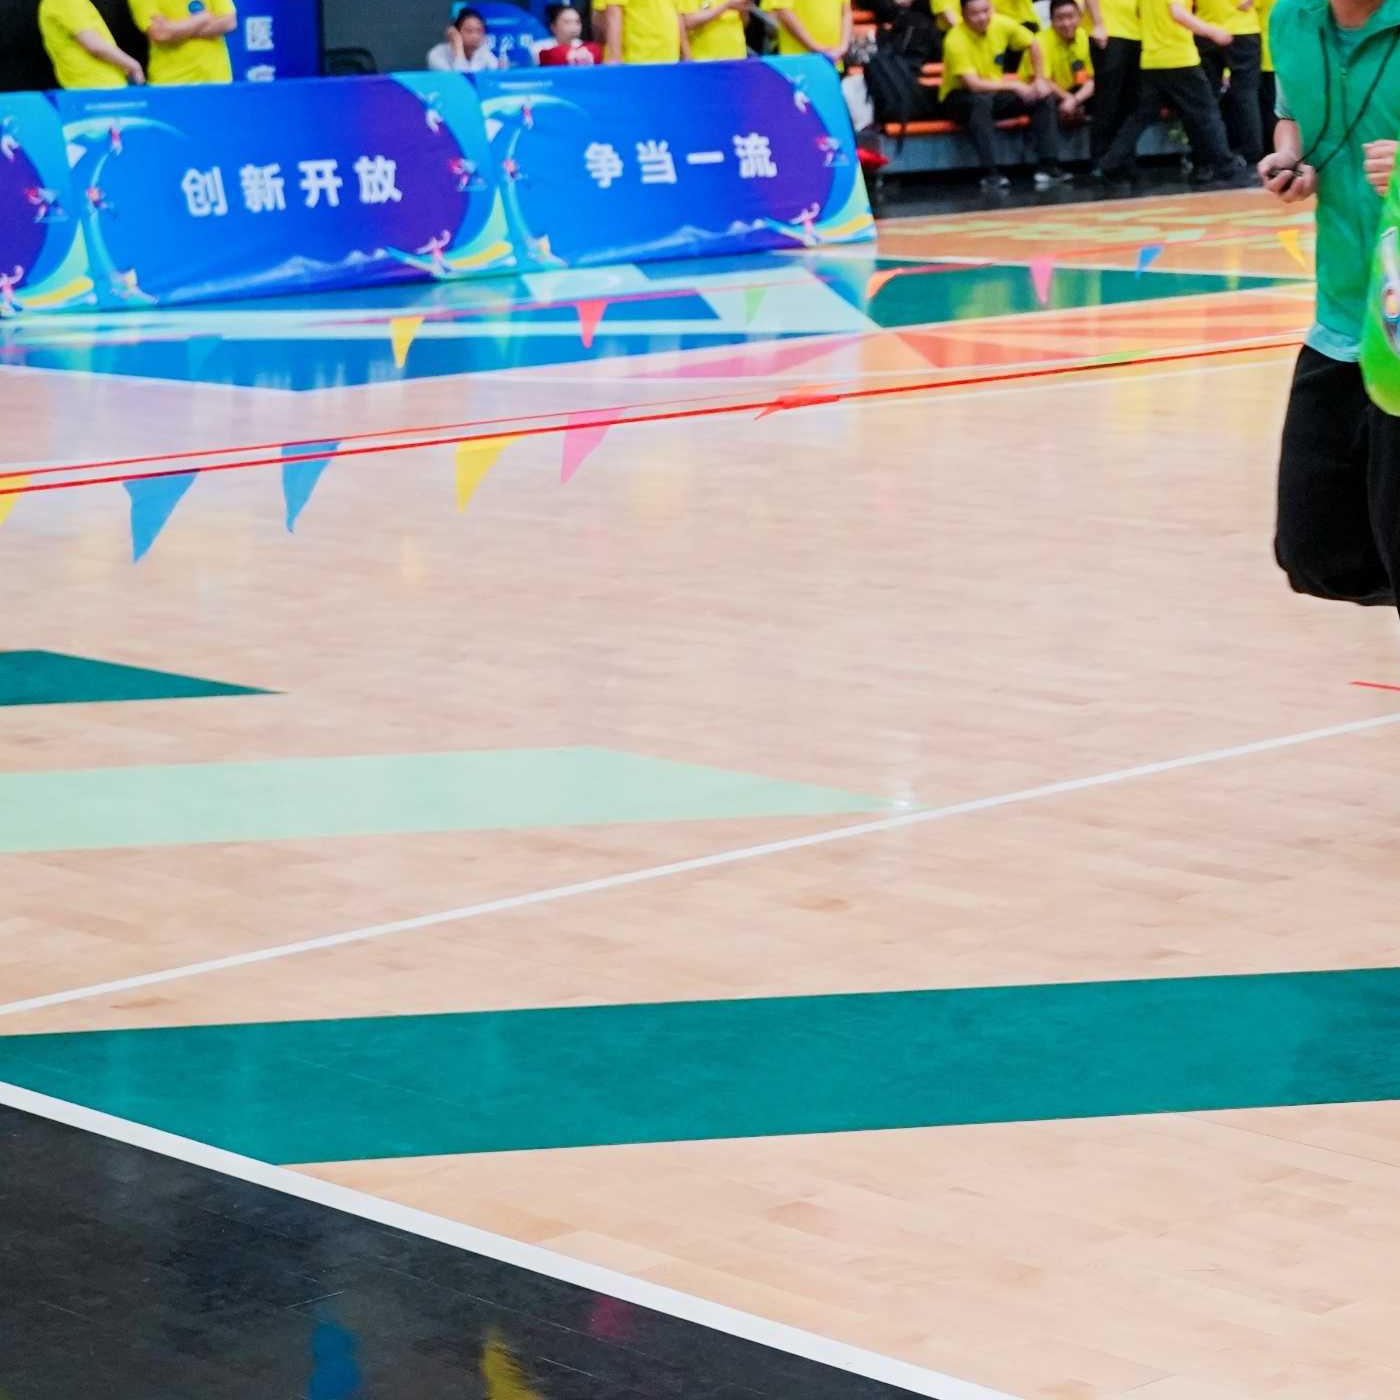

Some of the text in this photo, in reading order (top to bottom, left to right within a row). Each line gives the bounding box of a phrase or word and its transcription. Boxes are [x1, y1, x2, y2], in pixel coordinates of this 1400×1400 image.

[181, 155, 403, 216] 创新开放
[584, 132, 778, 189] 争当一流
